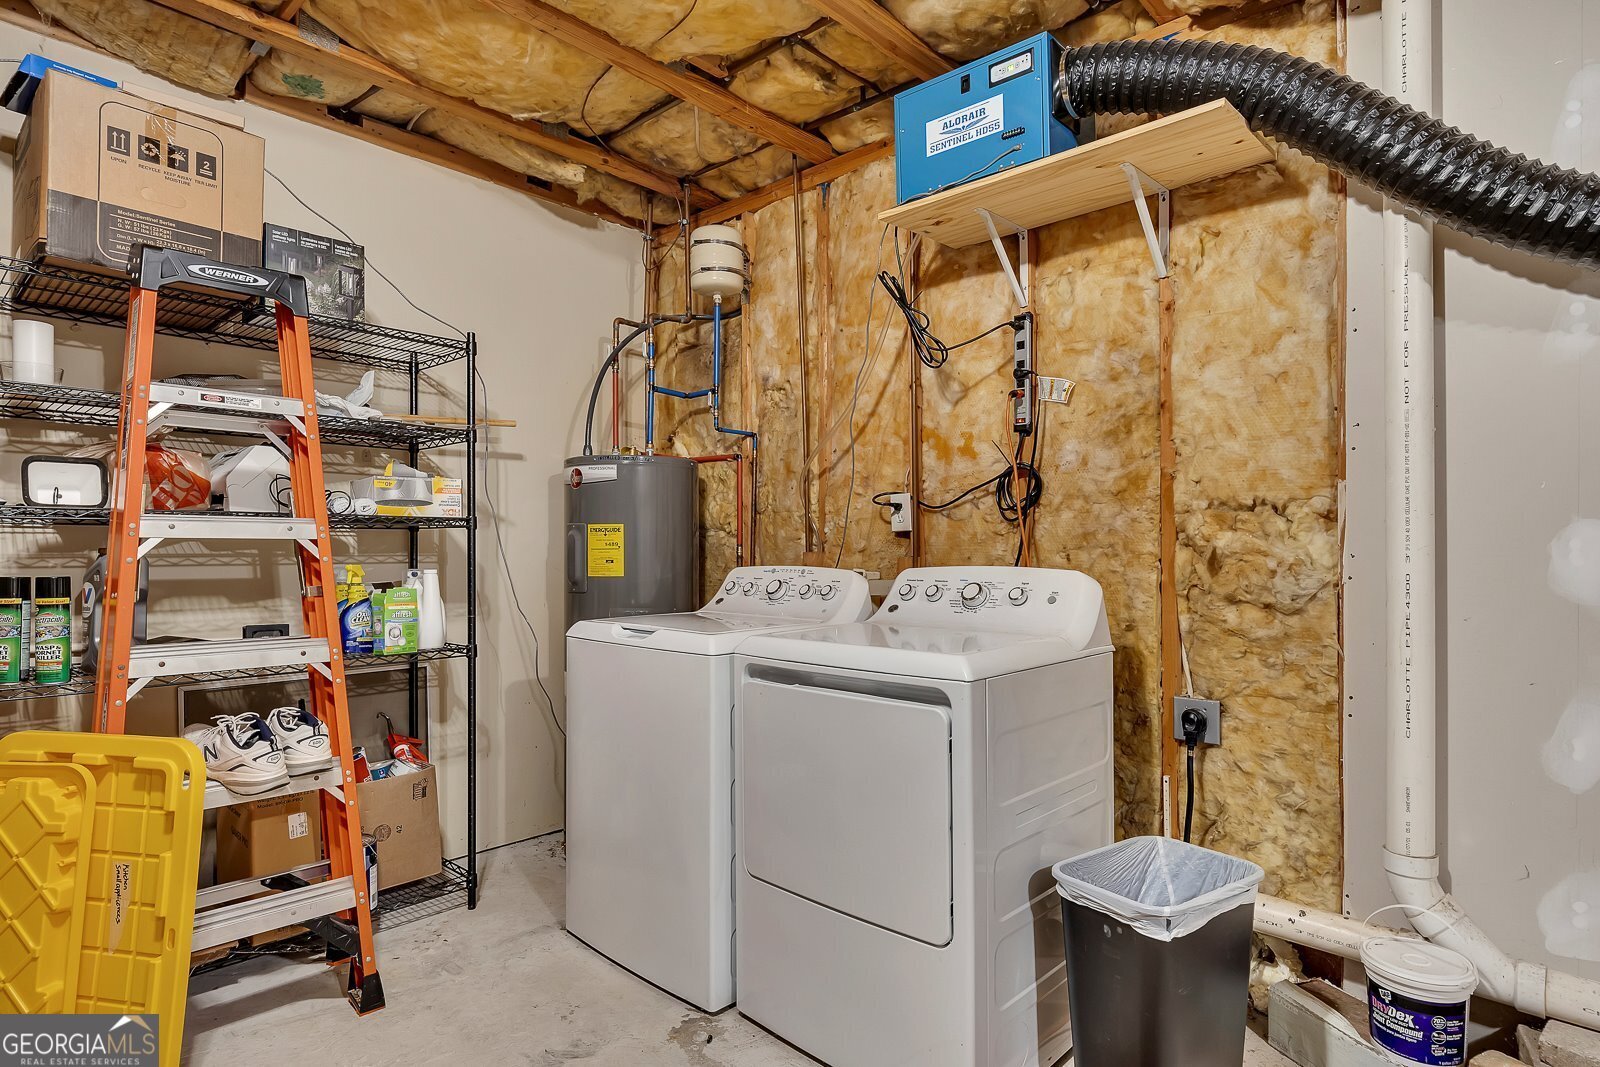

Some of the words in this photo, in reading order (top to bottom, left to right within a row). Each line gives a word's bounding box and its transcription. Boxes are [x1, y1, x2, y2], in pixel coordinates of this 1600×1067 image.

[942, 107, 986, 130] ALORAIR
[930, 133, 974, 154] SENTINEL
[110, 156, 127, 164] UPON
[138, 164, 161, 174] RECYCLE
[203, 161, 210, 170] 2
[164, 170, 176, 178] KEEP
[176, 174, 192, 182] AWAY
[164, 176, 191, 186] MOISTURE
[159, 219, 176, 228] Series
[204, 267, 254, 283] WERNER
[392, 610, 412, 618] affresh
[1386, 1018, 1423, 1038] Compound
